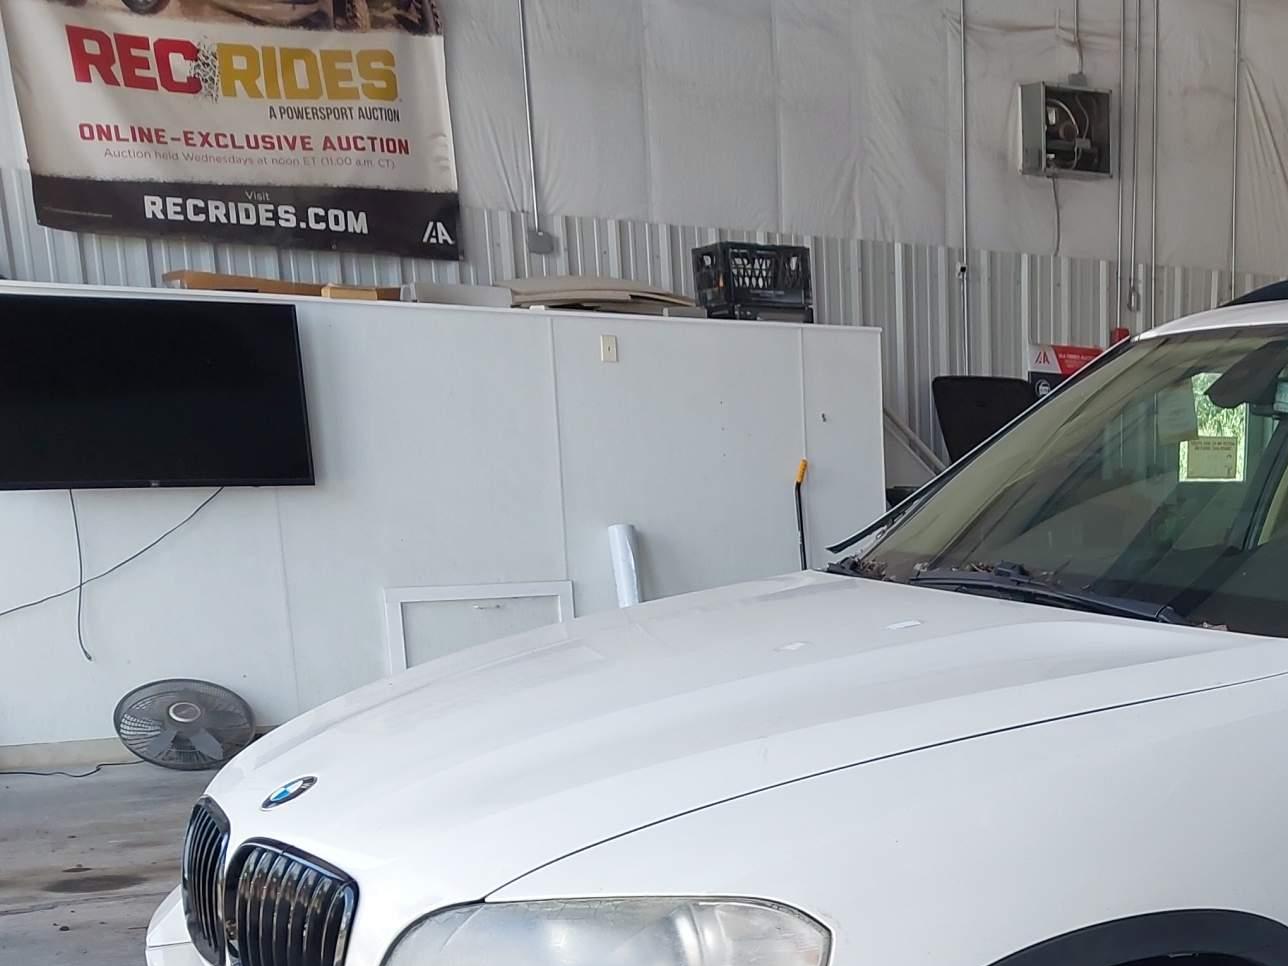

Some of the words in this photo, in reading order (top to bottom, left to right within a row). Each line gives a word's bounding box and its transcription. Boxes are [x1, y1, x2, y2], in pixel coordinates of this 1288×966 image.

[65, 25, 202, 95] REC
[216, 42, 398, 102] RIDES
[269, 106, 277, 120] A
[280, 106, 355, 121] POWERSPORT
[358, 107, 400, 122] AUCTION
[79, 123, 313, 152] ONLINE-EXCLUSIVE
[322, 135, 409, 155] AUCTION
[104, 148, 151, 160] Auction
[154, 150, 179, 161] held
[182, 152, 254, 166] Wednesdays
[257, 156, 267, 165] at
[271, 158, 300, 167] noon
[304, 156, 316, 167] ET
[245, 191, 270, 201] Visit
[143, 195, 368, 234] RECRIDES.COM
